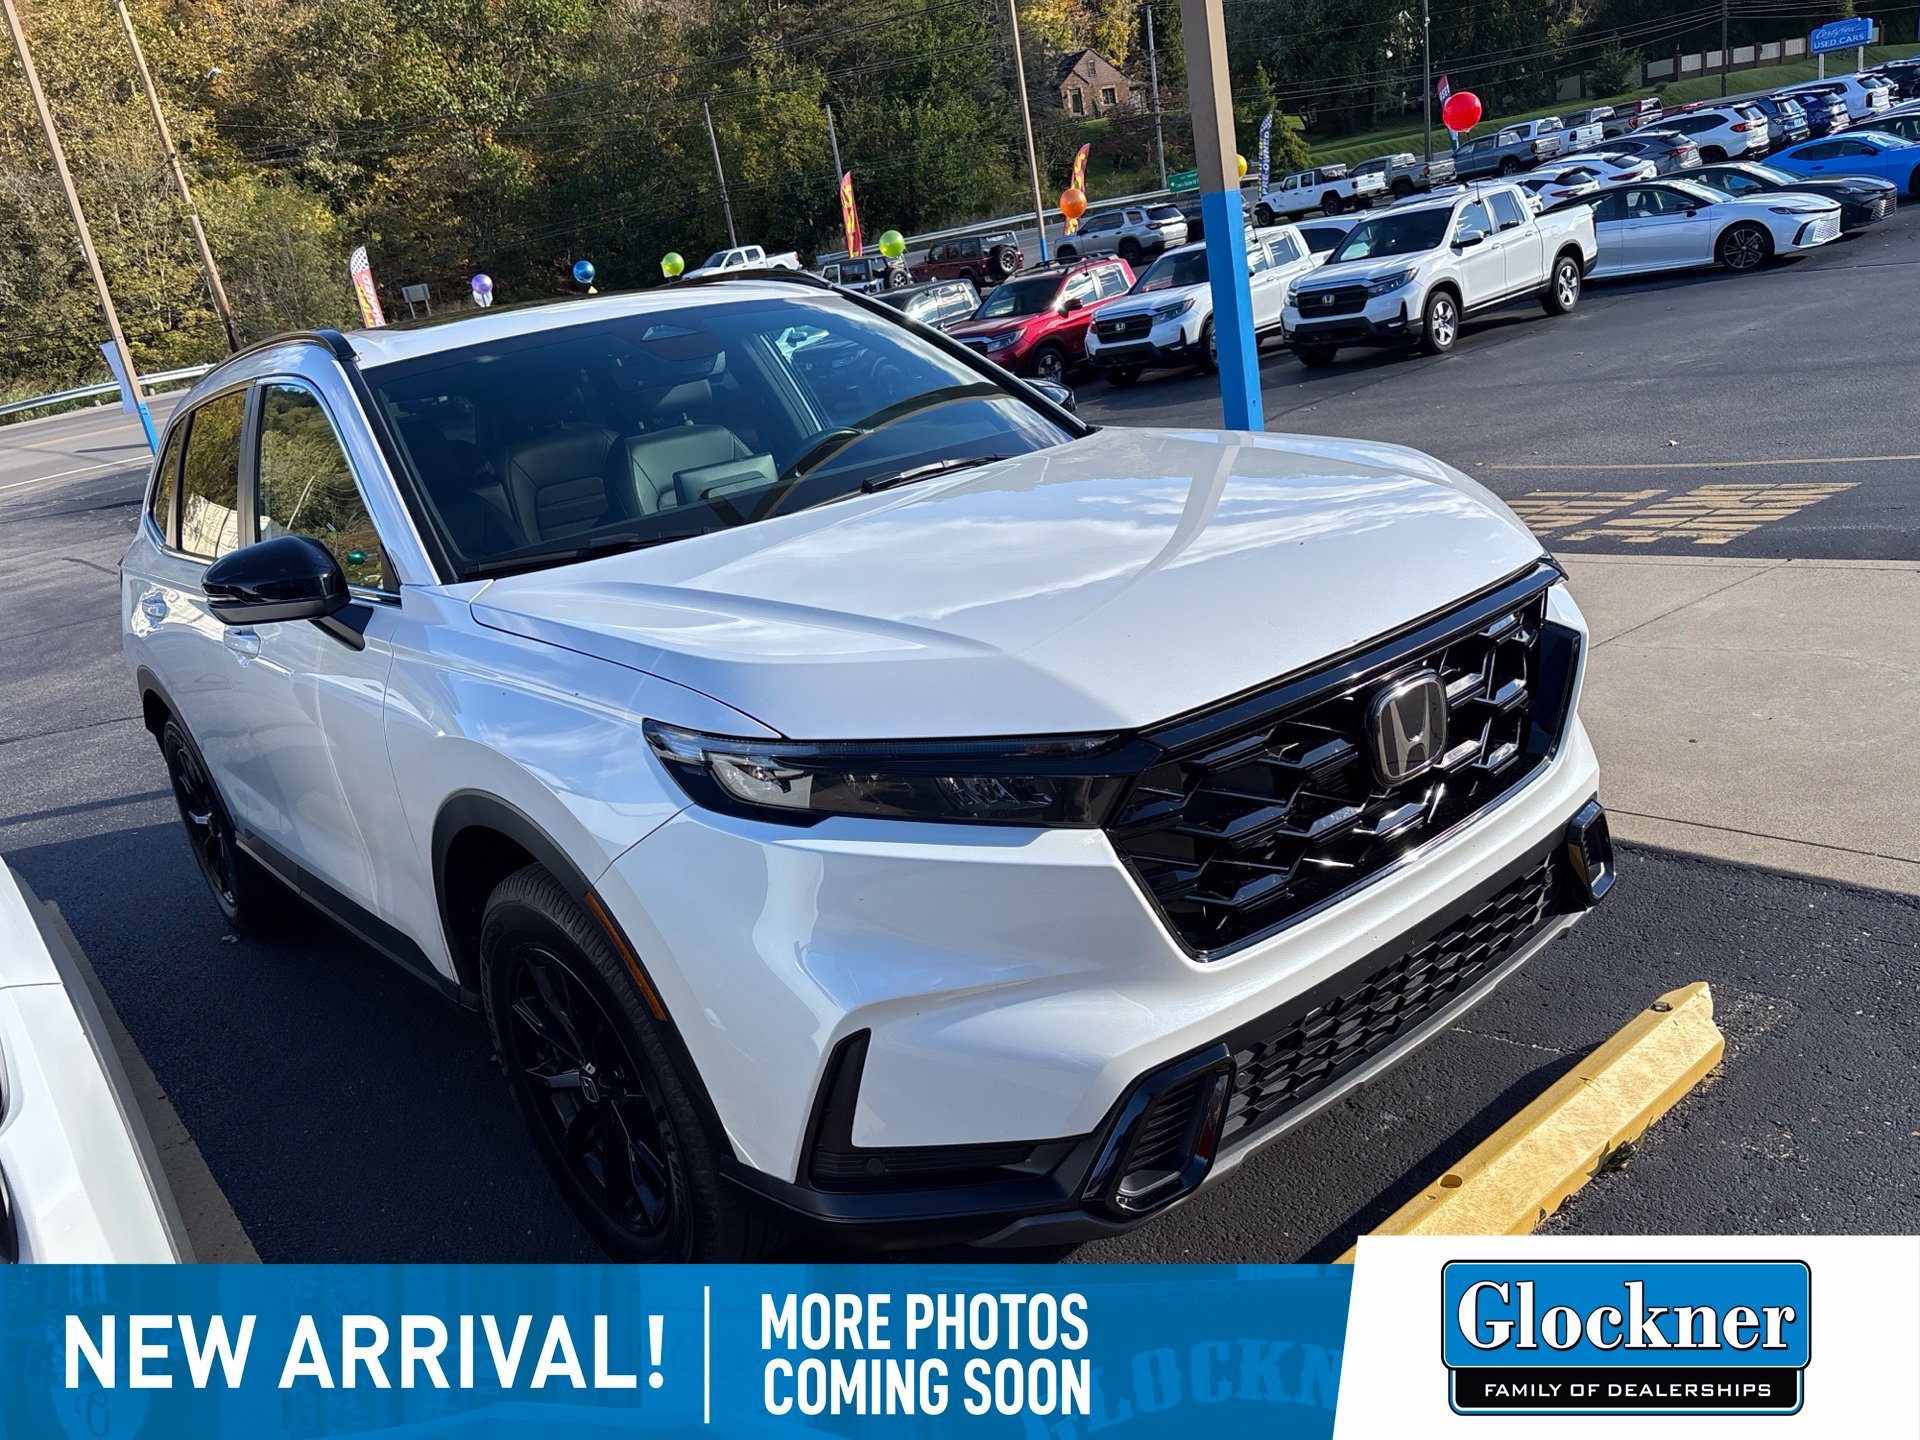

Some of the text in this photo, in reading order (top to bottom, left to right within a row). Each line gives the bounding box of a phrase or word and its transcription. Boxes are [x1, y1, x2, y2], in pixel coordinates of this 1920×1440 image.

[1813, 33, 1865, 50] USED CARS
[1261, 131, 1271, 195] PRE-OWNED
